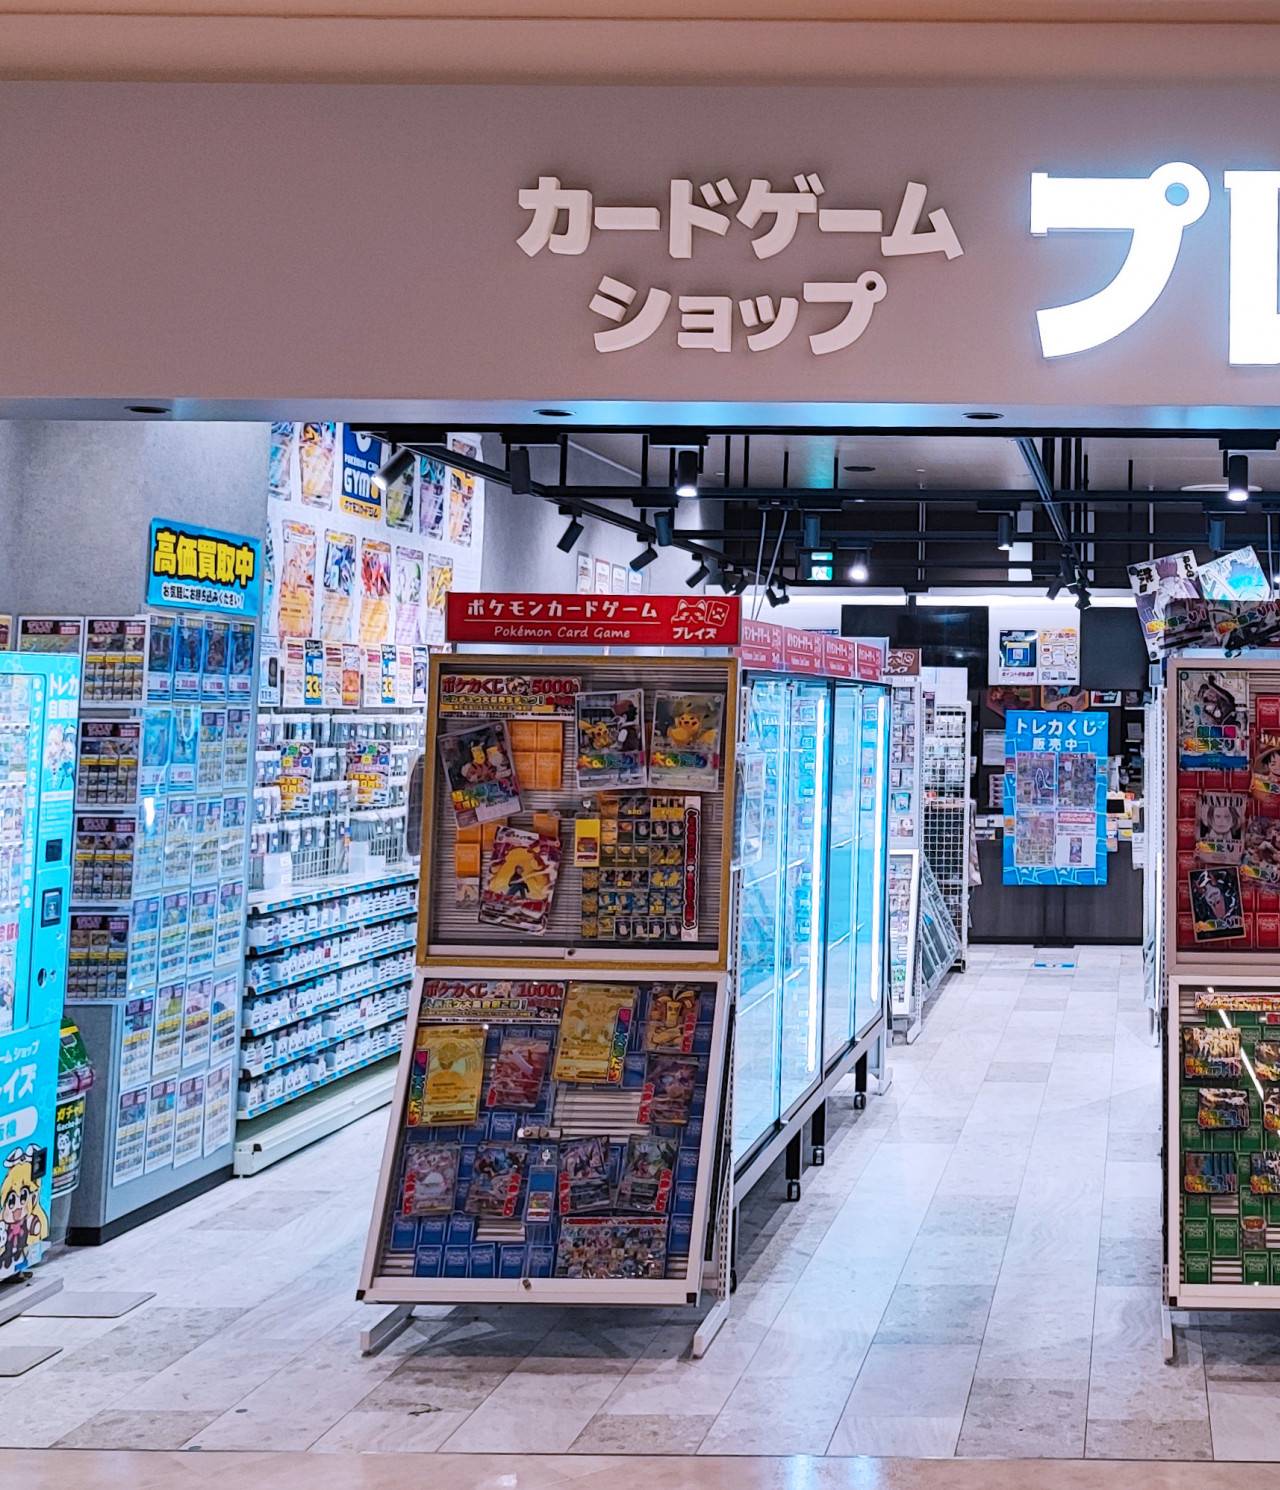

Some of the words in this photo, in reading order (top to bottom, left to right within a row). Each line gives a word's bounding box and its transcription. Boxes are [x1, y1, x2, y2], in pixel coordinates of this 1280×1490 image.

[516, 174, 966, 261] カードゲーム
[587, 270, 886, 355] ショップ
[344, 467, 371, 498] GYM
[153, 529, 255, 589] 高価買取中
[467, 599, 658, 618] ポケモンカードゲーム
[494, 625, 552, 638] Pokémon
[557, 627, 588, 638] Card
[594, 628, 631, 639] Game
[672, 627, 718, 640] プレイズ
[1016, 717, 1097, 736] トレカくじ
[1032, 737, 1078, 752] 販売中
[0, 1064, 37, 1104] イズ
